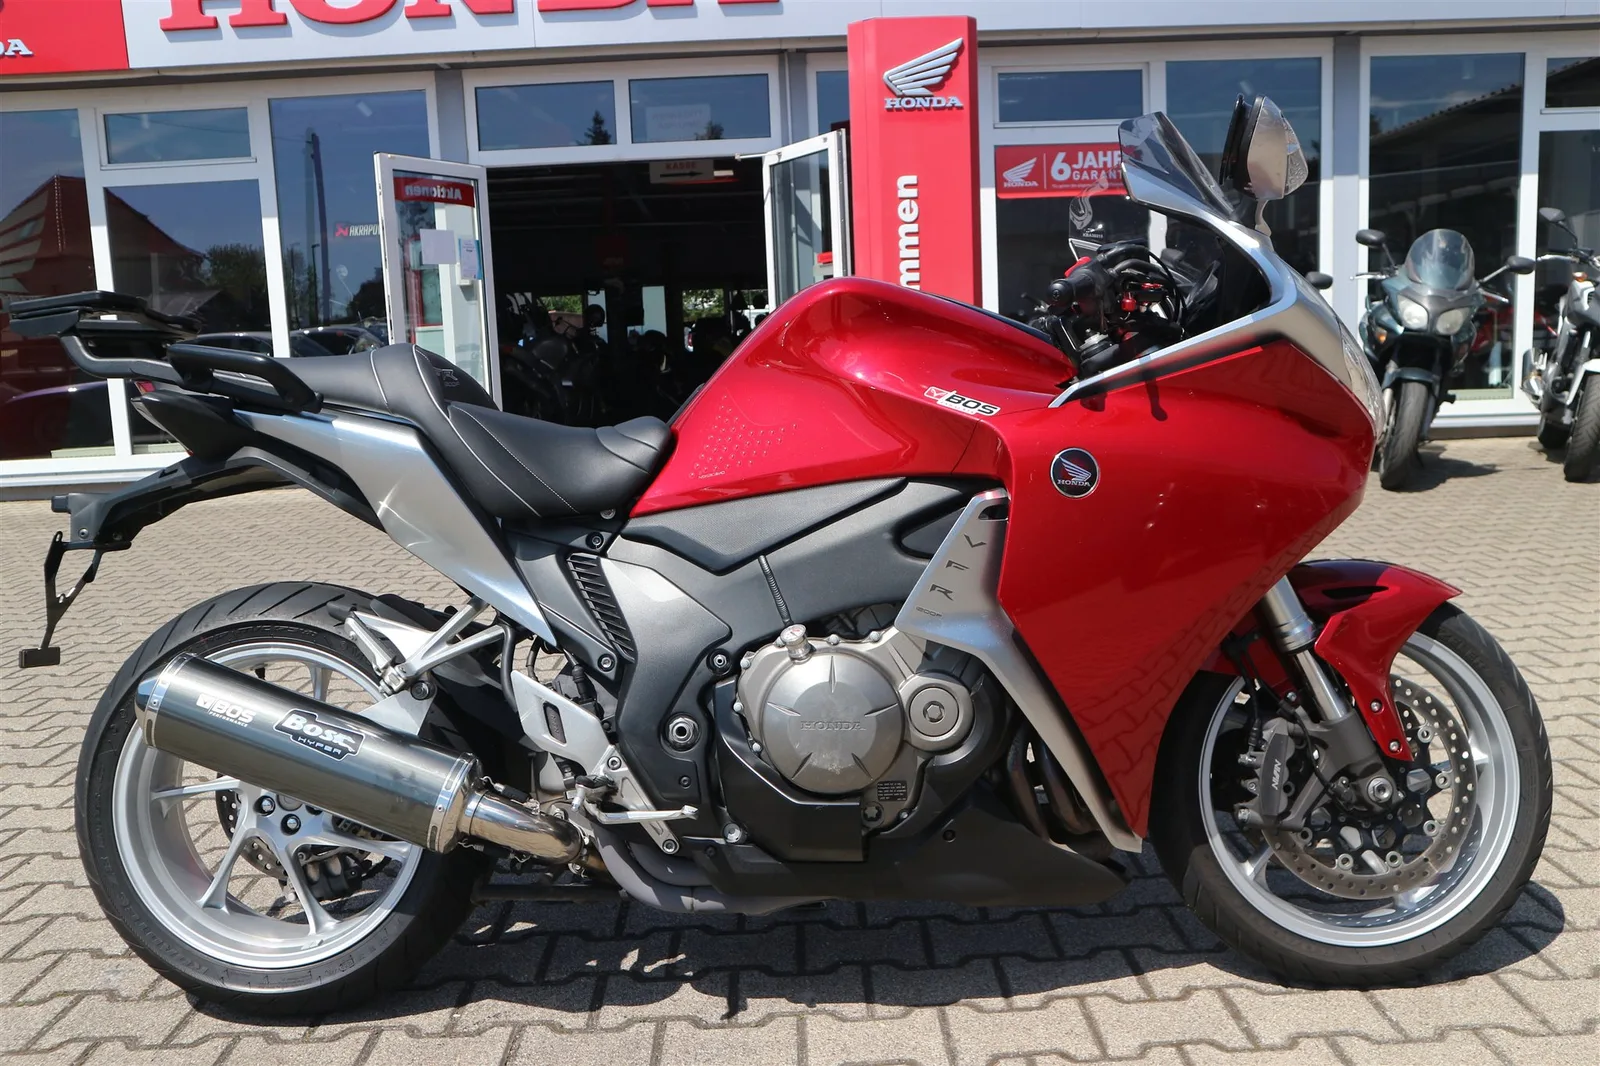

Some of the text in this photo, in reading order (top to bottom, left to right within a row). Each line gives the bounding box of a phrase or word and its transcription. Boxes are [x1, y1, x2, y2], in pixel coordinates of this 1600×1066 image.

[884, 96, 963, 109] HONDA
[1050, 151, 1071, 182] 6
[1003, 180, 1039, 188] HONDA
[945, 394, 998, 415] BOS
[1057, 478, 1092, 488] HONDA
[208, 711, 249, 728] PERFORMANCE
[211, 699, 257, 724] BOS
[800, 720, 867, 732] HONDA
[298, 735, 342, 755] HYPER
